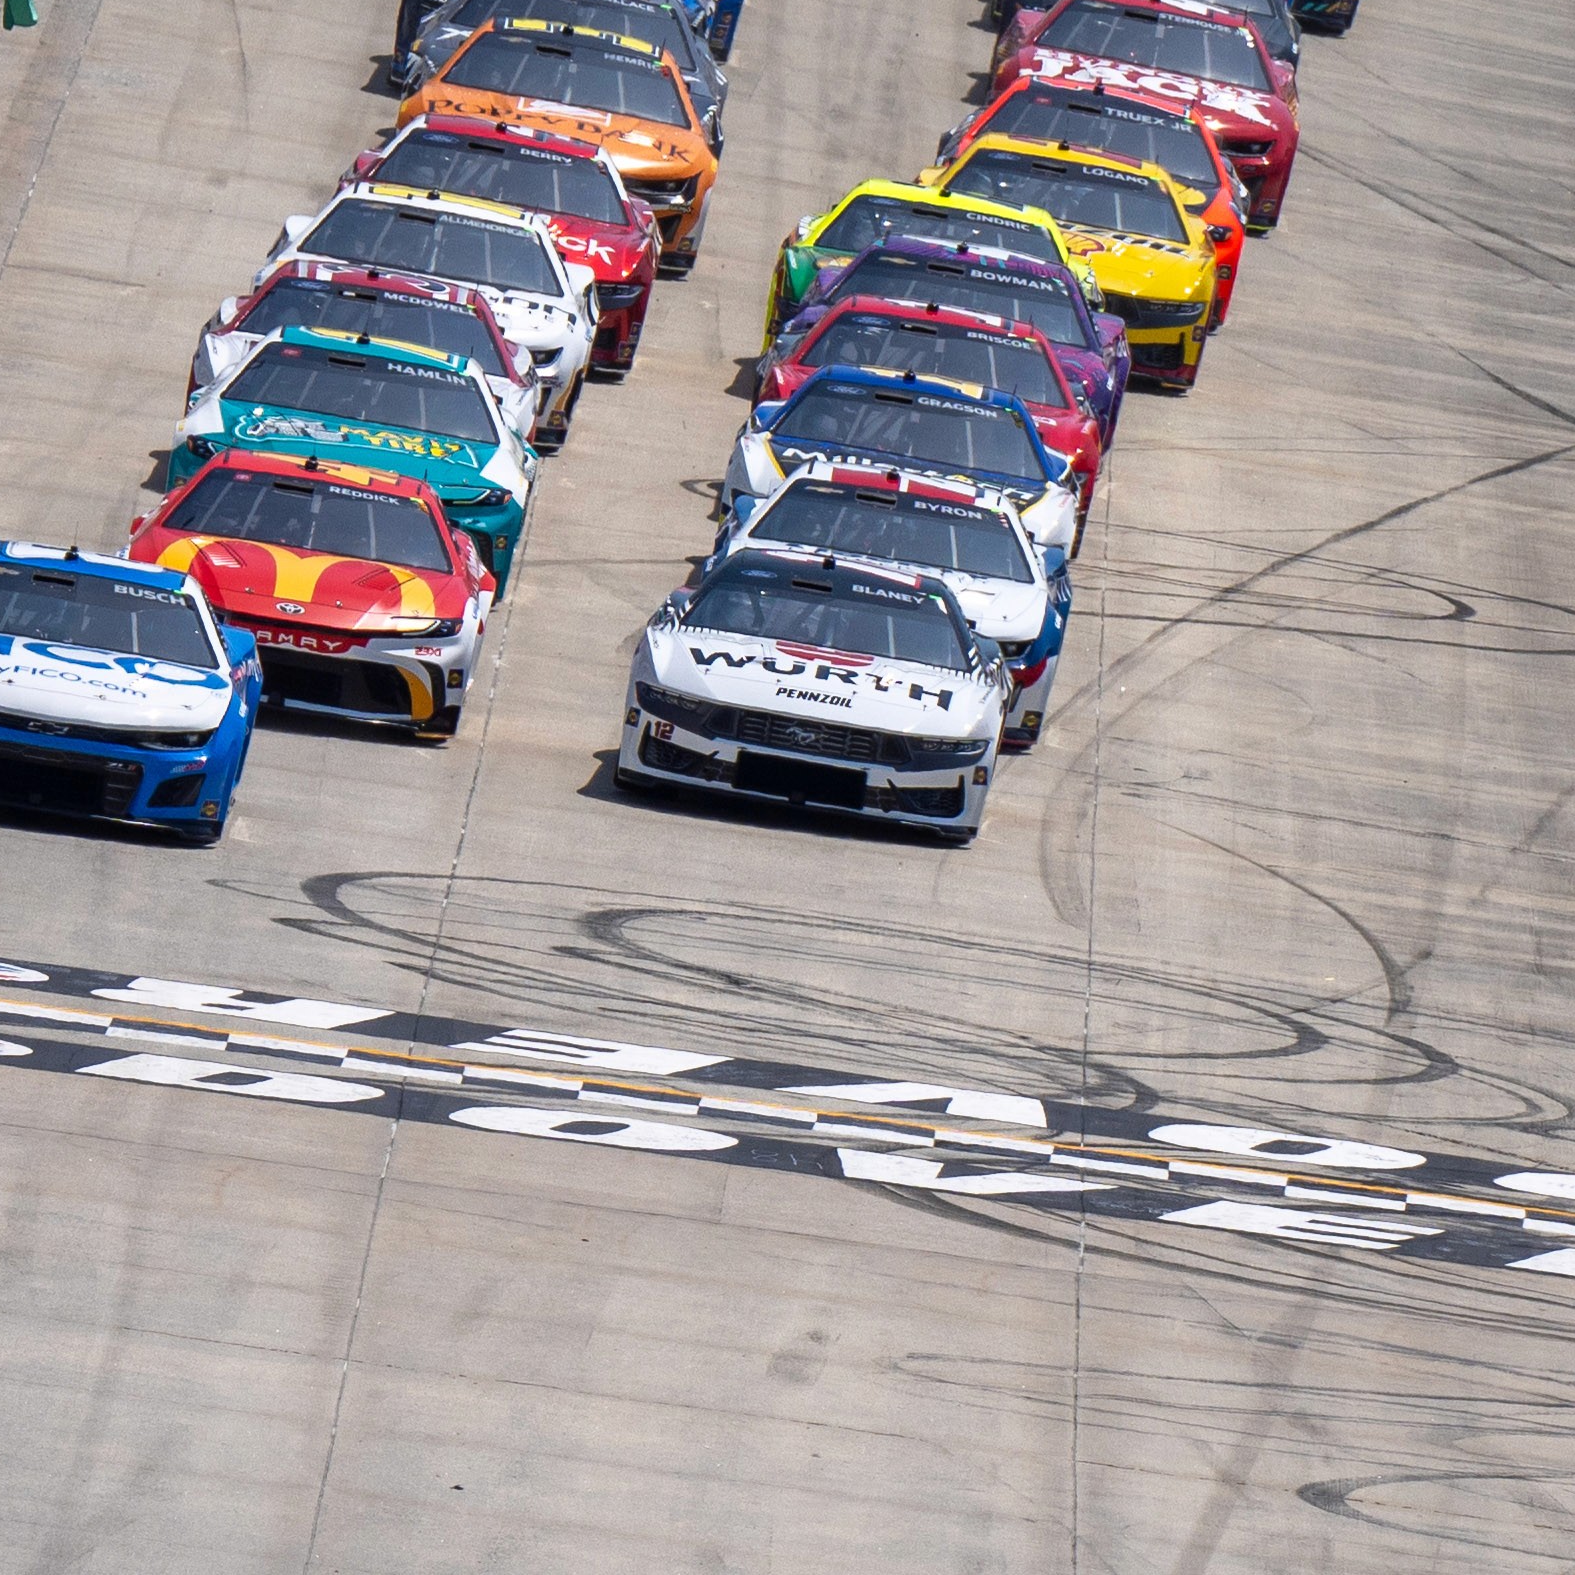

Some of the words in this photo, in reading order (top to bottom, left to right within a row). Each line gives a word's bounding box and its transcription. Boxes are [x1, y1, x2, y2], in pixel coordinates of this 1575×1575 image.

[1104, 107, 1164, 126] TRUEX
[1171, 121, 1192, 134] JR
[520, 148, 572, 164] BERRY
[1082, 166, 1149, 186] LOGANO
[966, 213, 1030, 232] CINDRIC
[971, 269, 1053, 291] BOWMAN
[967, 330, 1031, 351] BRISCOE
[387, 362, 466, 386] HAMLIN
[917, 397, 997, 419] GRAGSON
[329, 485, 400, 506] REDDICK
[914, 501, 982, 520] BYRON
[114, 584, 186, 607] BUSCH
[852, 584, 926, 605] BLANEY
[256, 630, 342, 652] AMRY
[689, 647, 953, 711] WÜRTH
[775, 687, 852, 709] PENNZOIL
[655, 720, 675, 741] 12
